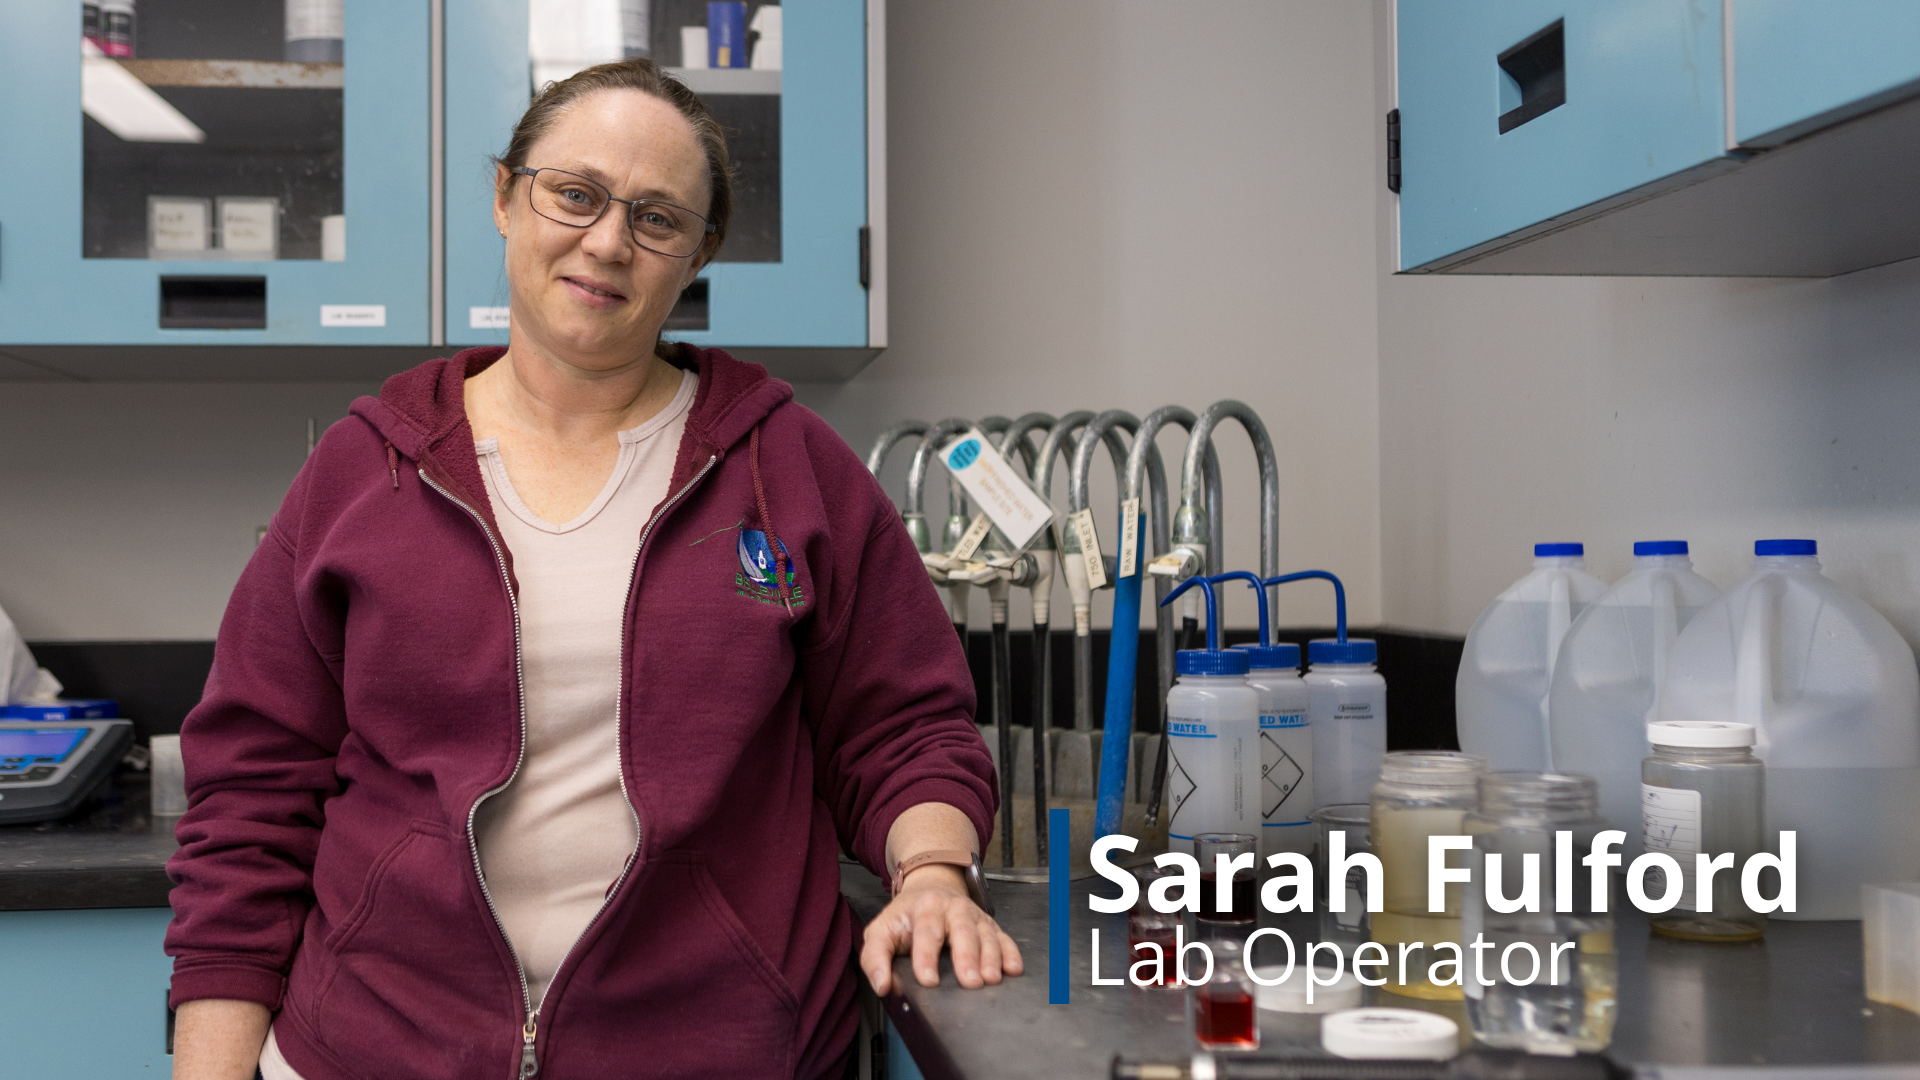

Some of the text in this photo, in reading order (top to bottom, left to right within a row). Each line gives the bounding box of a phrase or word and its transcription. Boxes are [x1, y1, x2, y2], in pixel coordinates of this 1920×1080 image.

[979, 477, 1014, 517] SAMPLE SITE
[990, 471, 1016, 501] FINISHED
[1012, 497, 1035, 522] WATER
[1081, 522, 1100, 577] 750 INLET
[1124, 501, 1136, 572] RAW WATER
[1174, 723, 1207, 734] WATER
